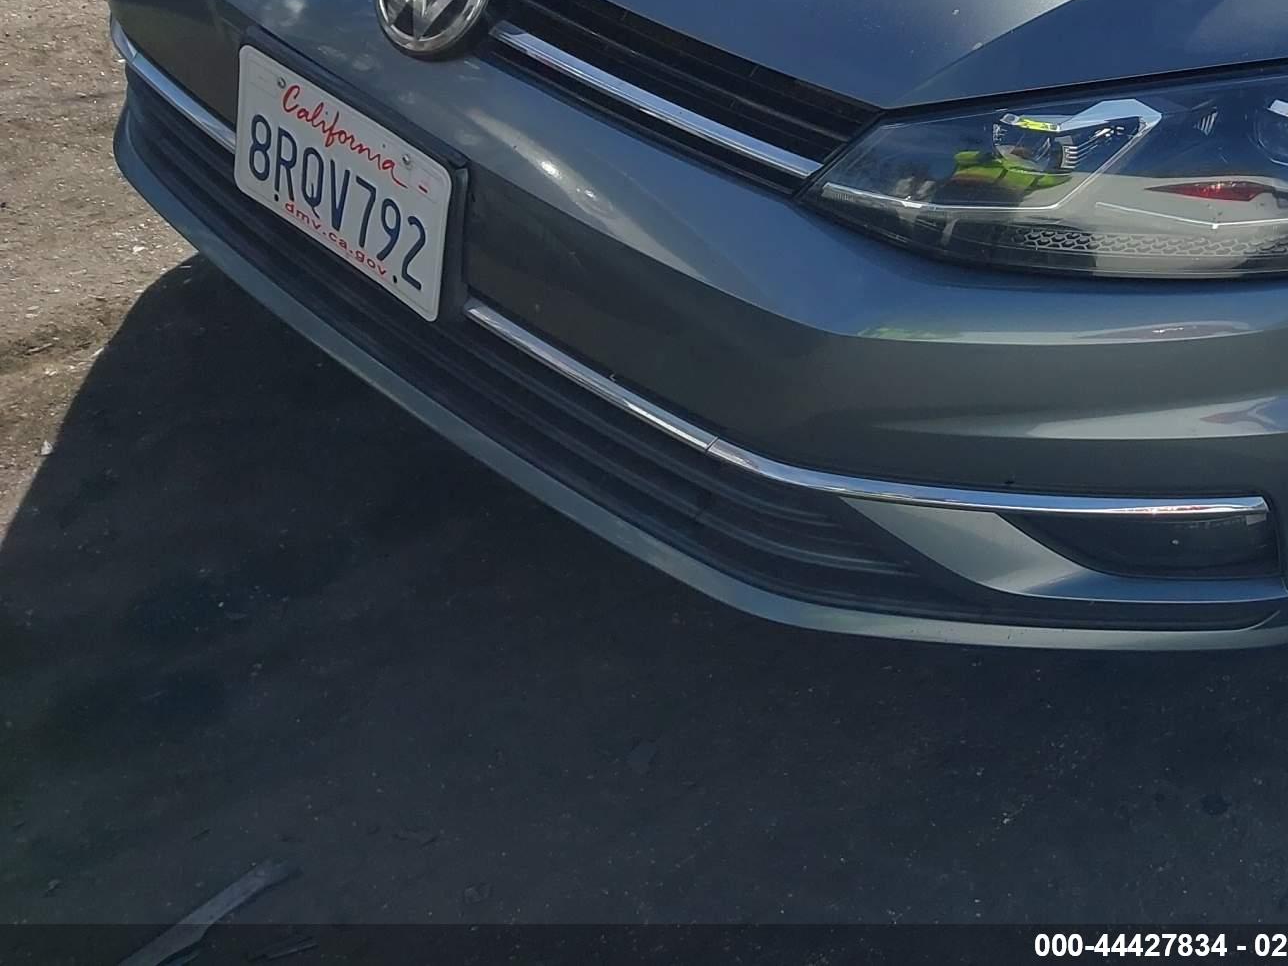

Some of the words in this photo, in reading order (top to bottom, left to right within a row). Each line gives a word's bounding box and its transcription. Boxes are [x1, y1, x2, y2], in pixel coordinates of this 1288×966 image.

[282, 84, 409, 190] California
[249, 114, 427, 291] 8RQV792
[284, 200, 388, 277] dmv.ca.gov
